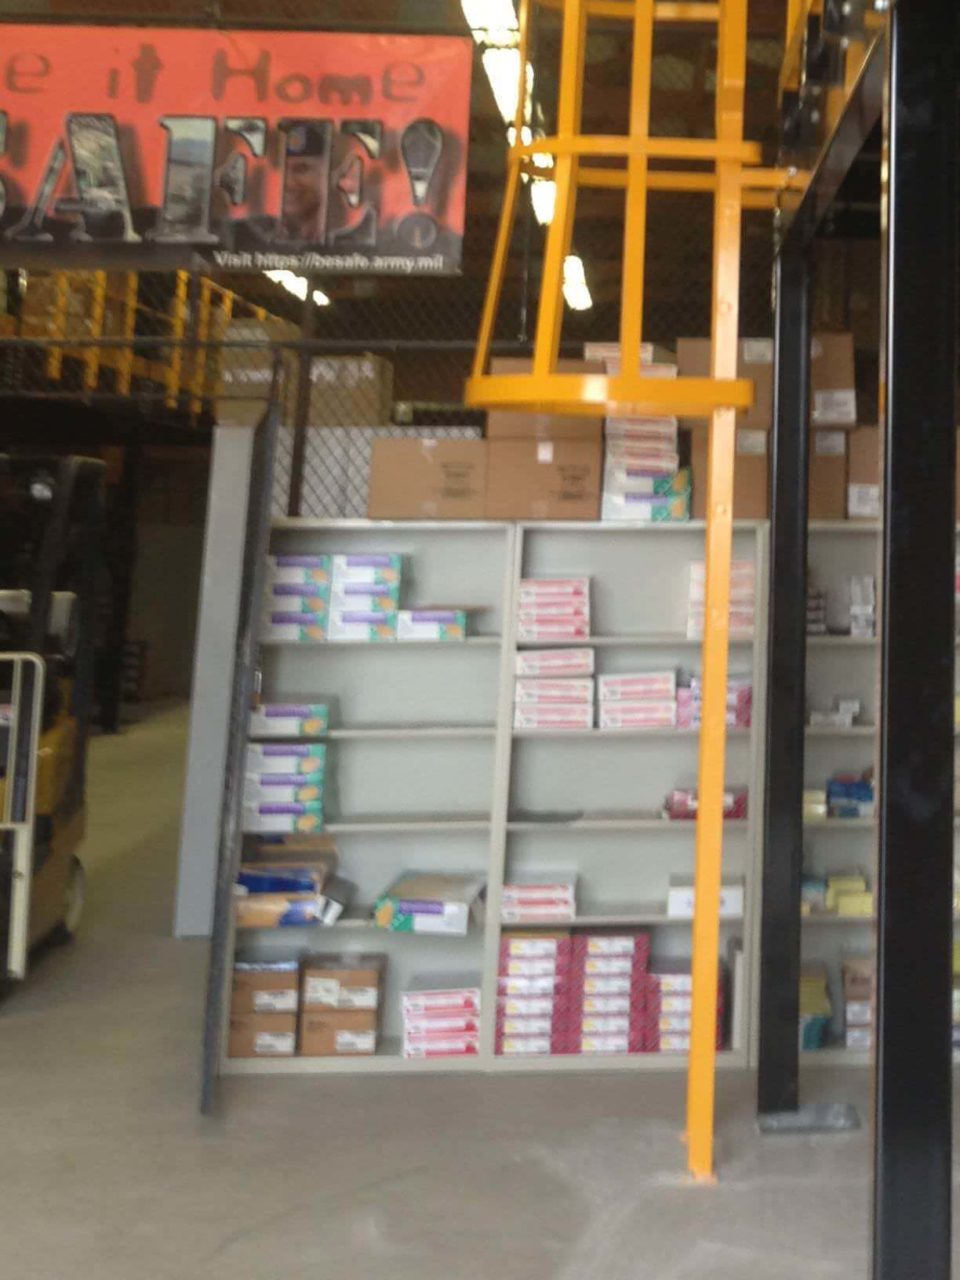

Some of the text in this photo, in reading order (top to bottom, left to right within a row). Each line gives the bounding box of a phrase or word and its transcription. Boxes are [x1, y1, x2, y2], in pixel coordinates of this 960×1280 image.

[107, 43, 162, 104] it
[212, 49, 426, 106] Home
[0, 111, 443, 250] AFE!
[214, 251, 251, 268] Visit
